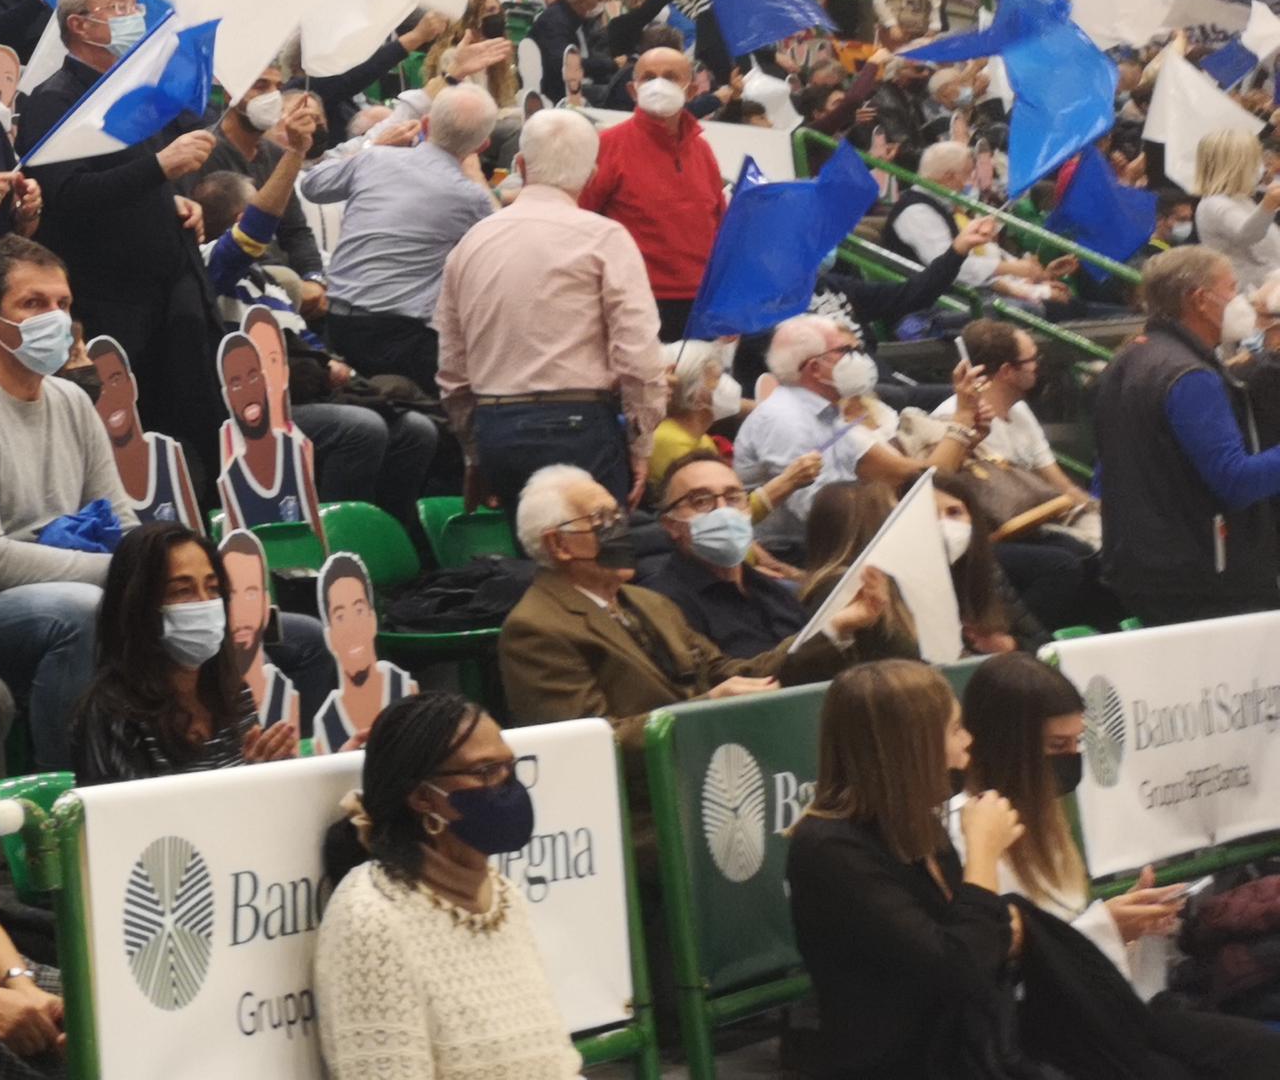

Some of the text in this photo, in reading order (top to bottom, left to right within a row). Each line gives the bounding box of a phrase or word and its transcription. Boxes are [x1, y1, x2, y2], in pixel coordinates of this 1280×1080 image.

[229, 826, 595, 947] Ban egna
[237, 988, 316, 1040] Grupp
